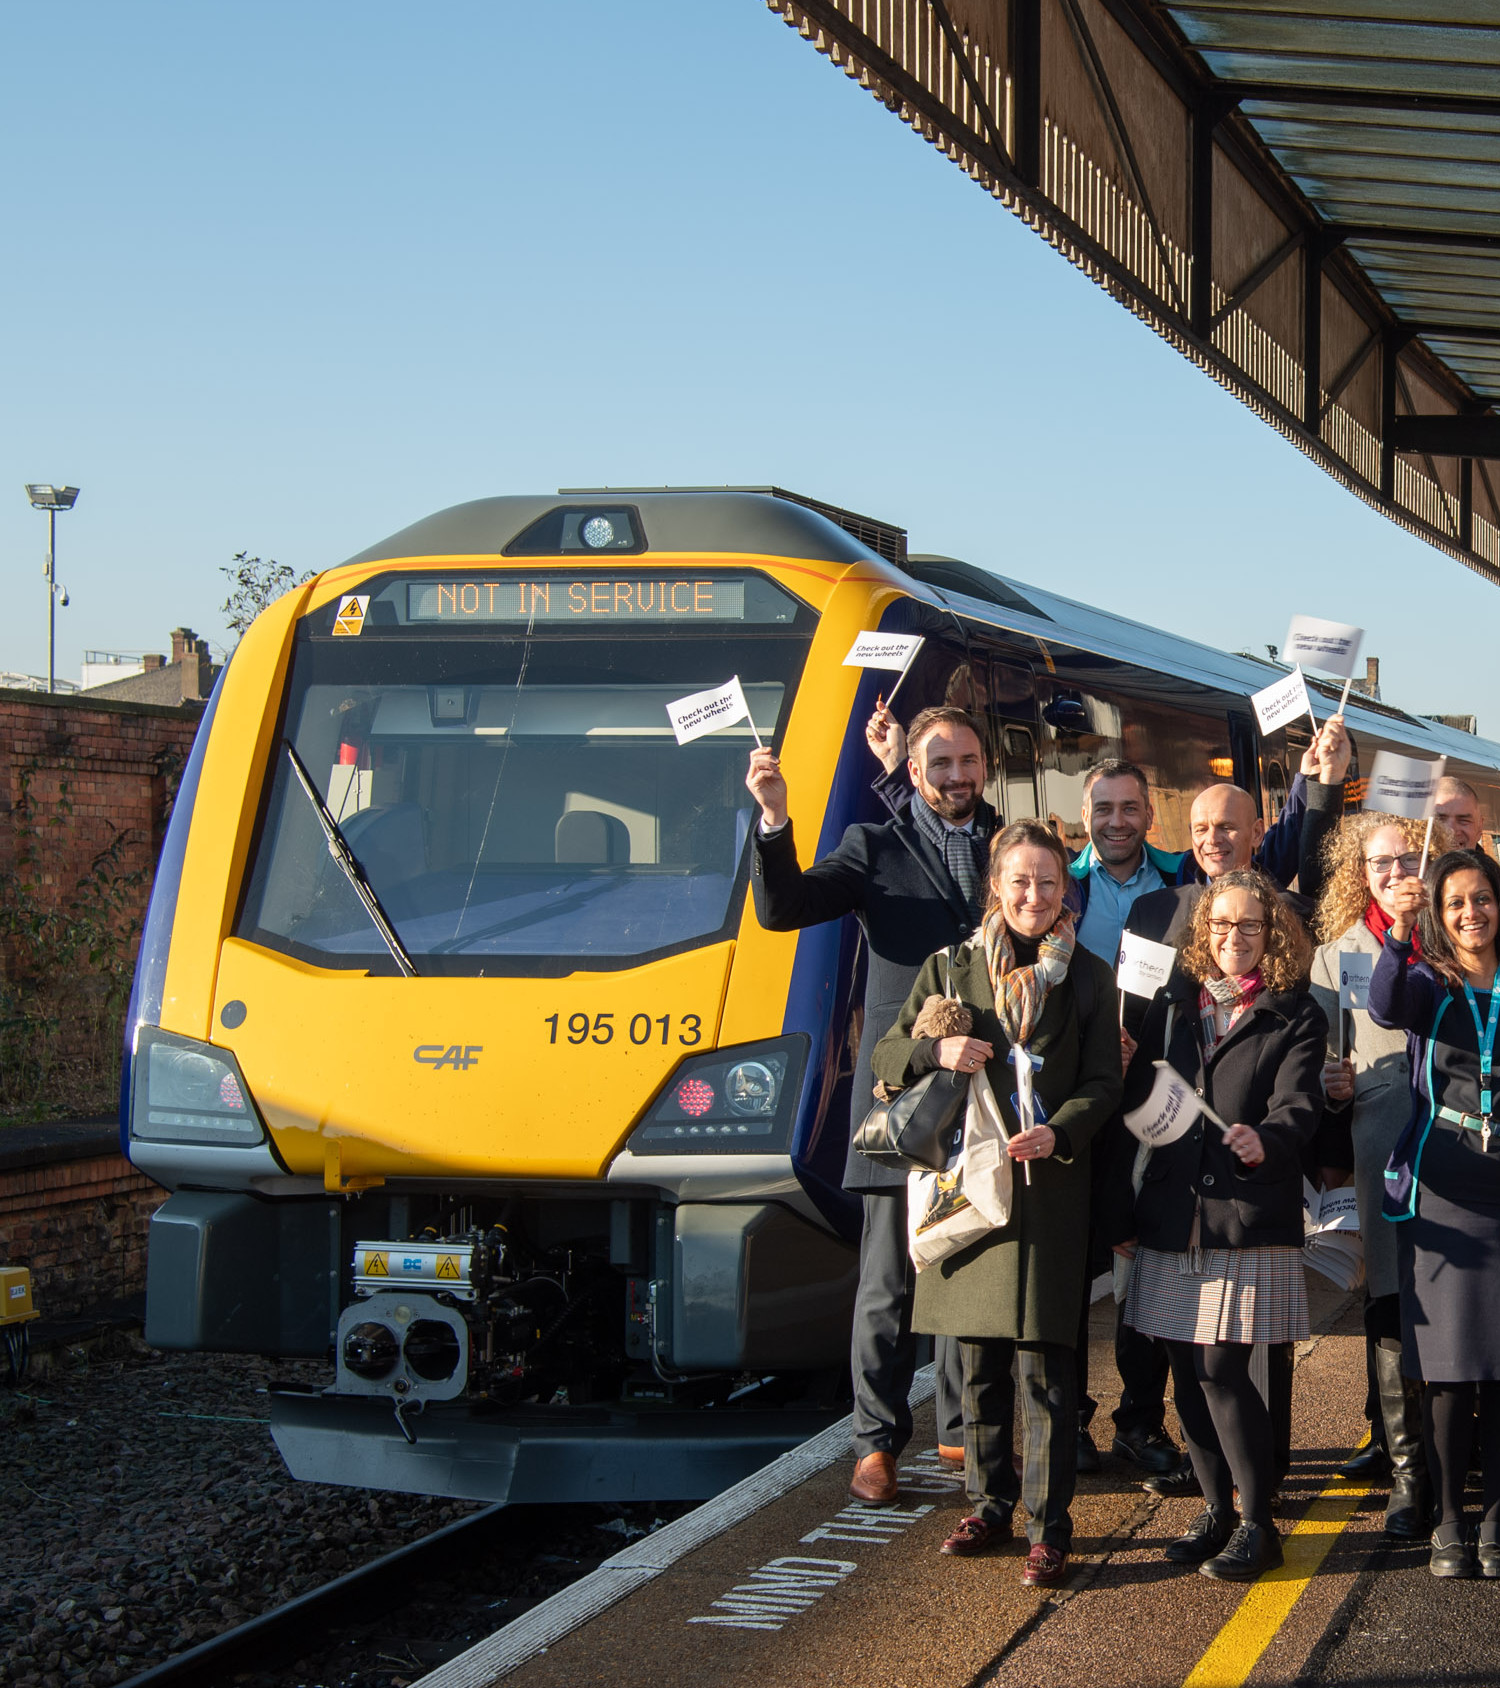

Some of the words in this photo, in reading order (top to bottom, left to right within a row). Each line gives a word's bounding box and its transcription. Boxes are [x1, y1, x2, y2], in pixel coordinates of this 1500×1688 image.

[438, 583, 500, 613] NOT
[519, 583, 550, 613] IN
[568, 581, 713, 613] SERVICE
[677, 707, 703, 725] Check
[703, 701, 719, 712] out
[1261, 699, 1281, 716] Check
[1281, 689, 1293, 701] out
[1266, 708, 1280, 721] new
[683, 717, 702, 731] new
[703, 702, 734, 720] wheels
[544, 1013, 614, 1044] 195
[629, 1013, 702, 1045] 013
[413, 1044, 483, 1070] CAF
[1336, 1204, 1358, 1212] heck
[687, 1556, 857, 1630] MIND
[799, 1504, 936, 1544] THE
